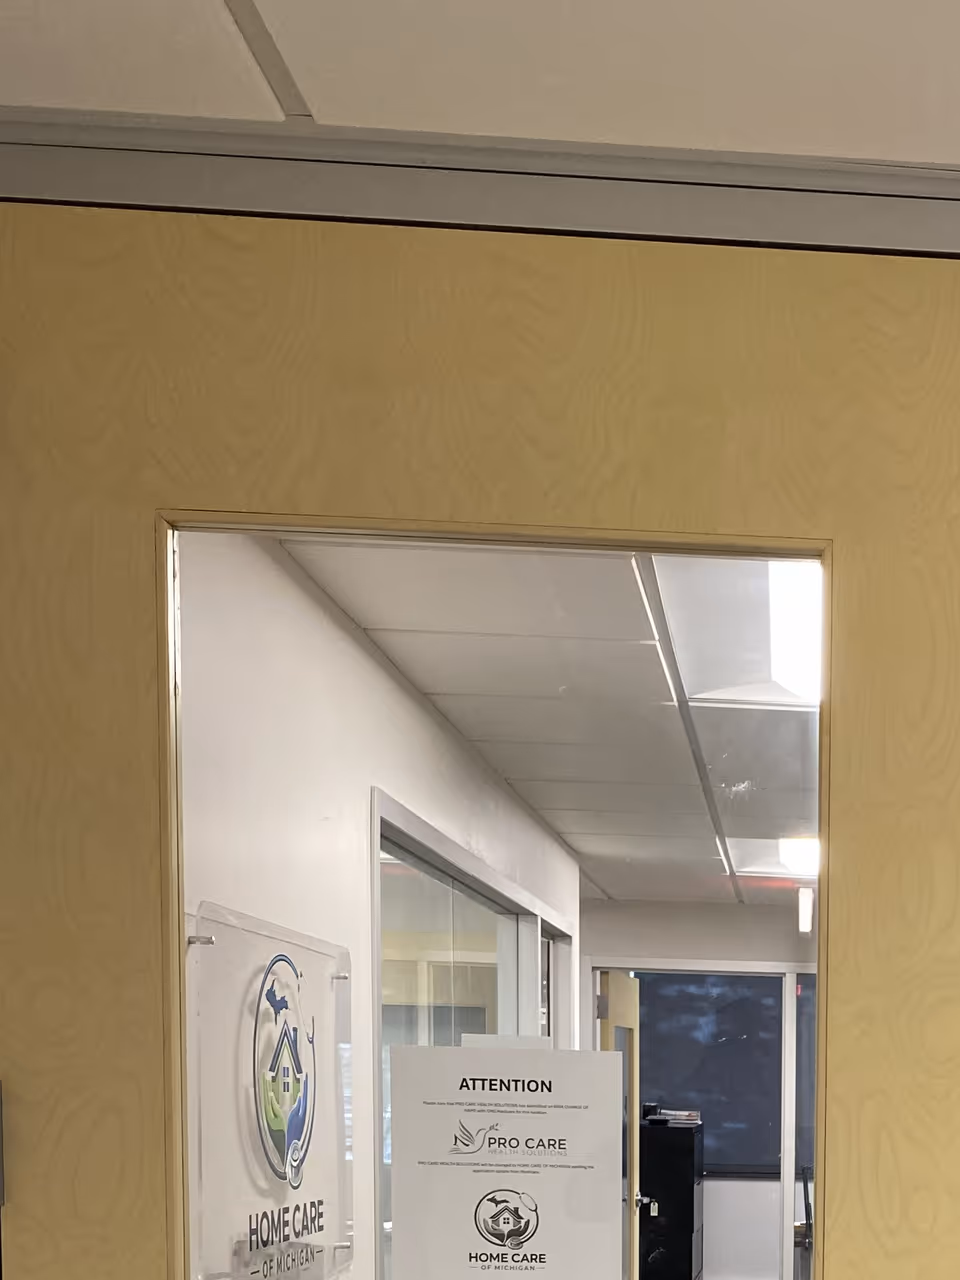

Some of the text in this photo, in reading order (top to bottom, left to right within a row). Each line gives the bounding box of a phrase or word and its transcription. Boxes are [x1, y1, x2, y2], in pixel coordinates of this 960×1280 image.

[458, 1077, 552, 1093] ATTENTION
[487, 1136, 567, 1150] PRO CARE
[248, 1199, 324, 1252] HOME CARE
[262, 1246, 315, 1279] OF MICHIGAN
[468, 1252, 547, 1264] HOME CARE
